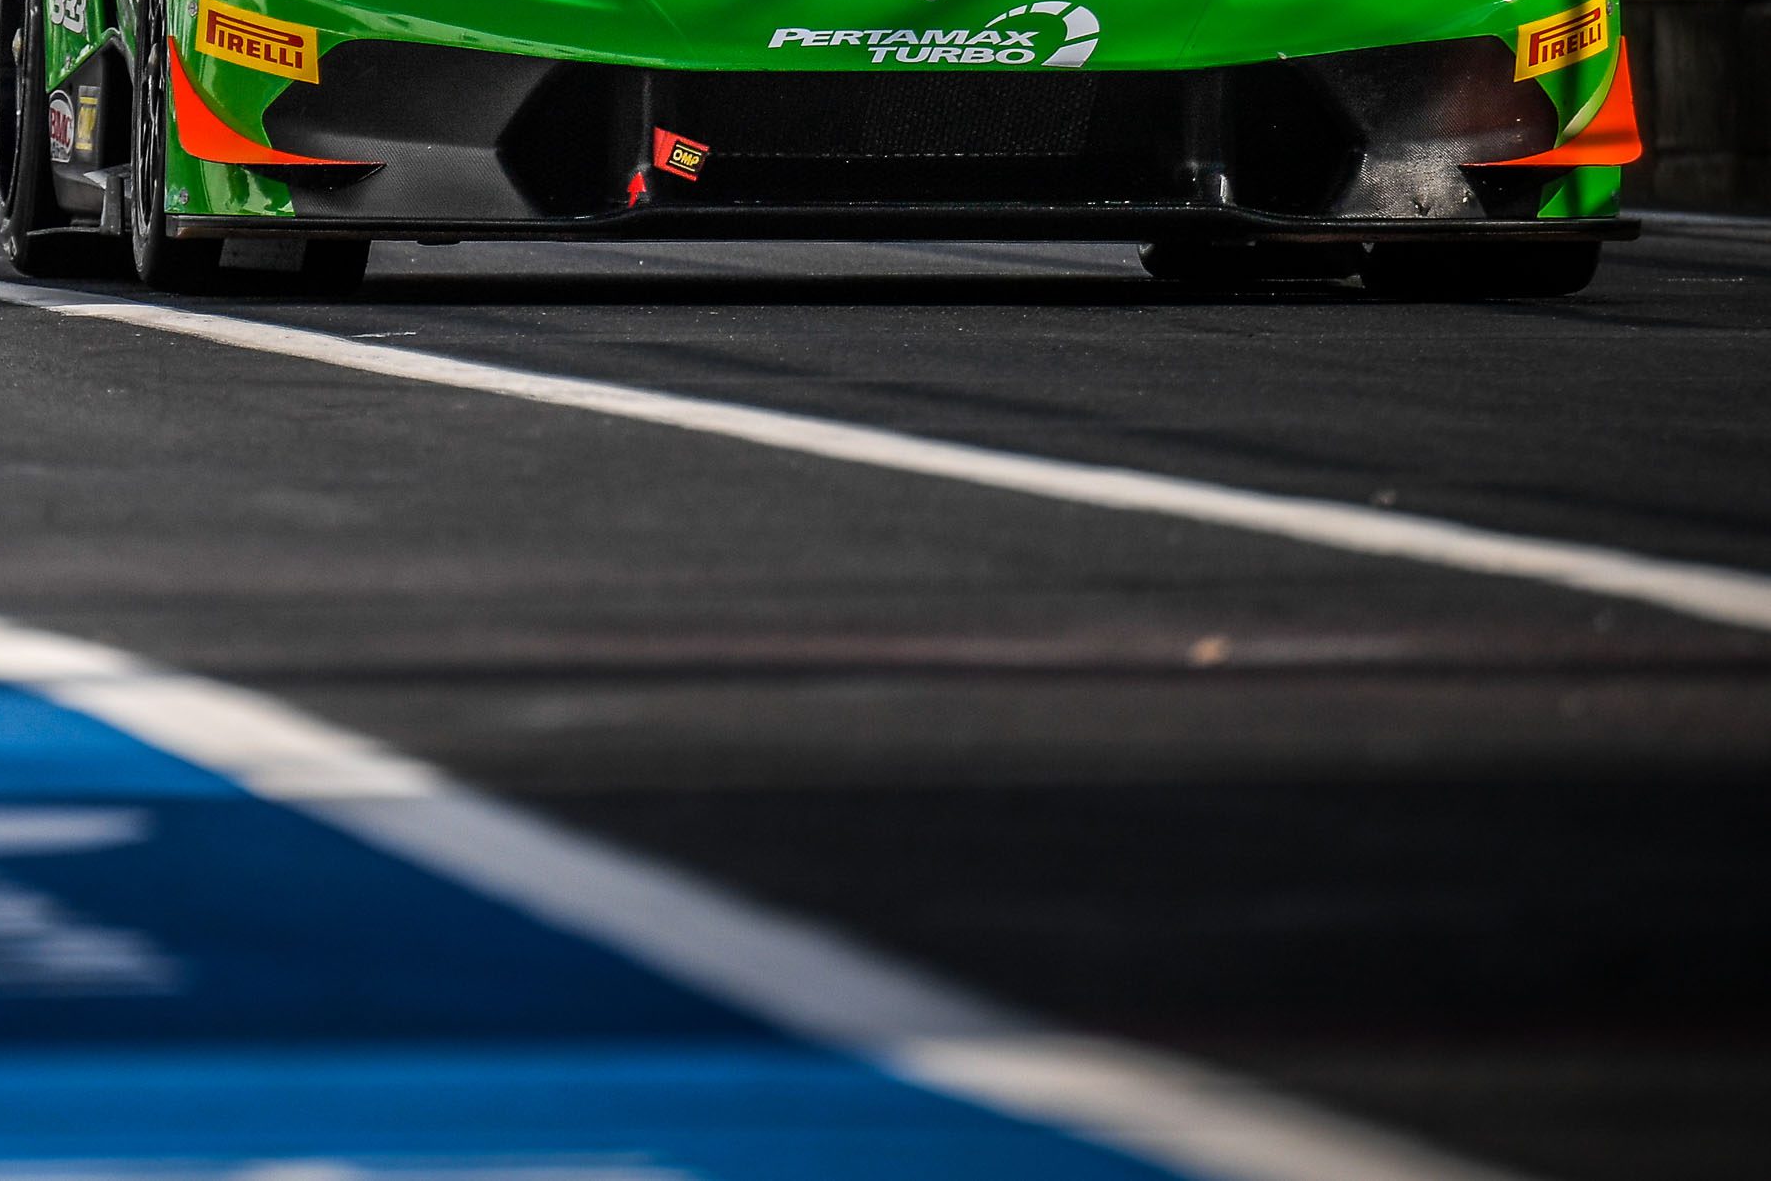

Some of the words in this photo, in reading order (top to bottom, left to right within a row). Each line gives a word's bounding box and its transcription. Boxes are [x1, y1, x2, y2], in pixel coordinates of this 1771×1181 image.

[205, 8, 304, 69] PIRELLI
[767, 27, 1042, 49] PERTAMAX
[1528, 7, 1602, 67] PIRELLI
[867, 46, 1036, 64] TURBO
[672, 148, 700, 167] OMP
